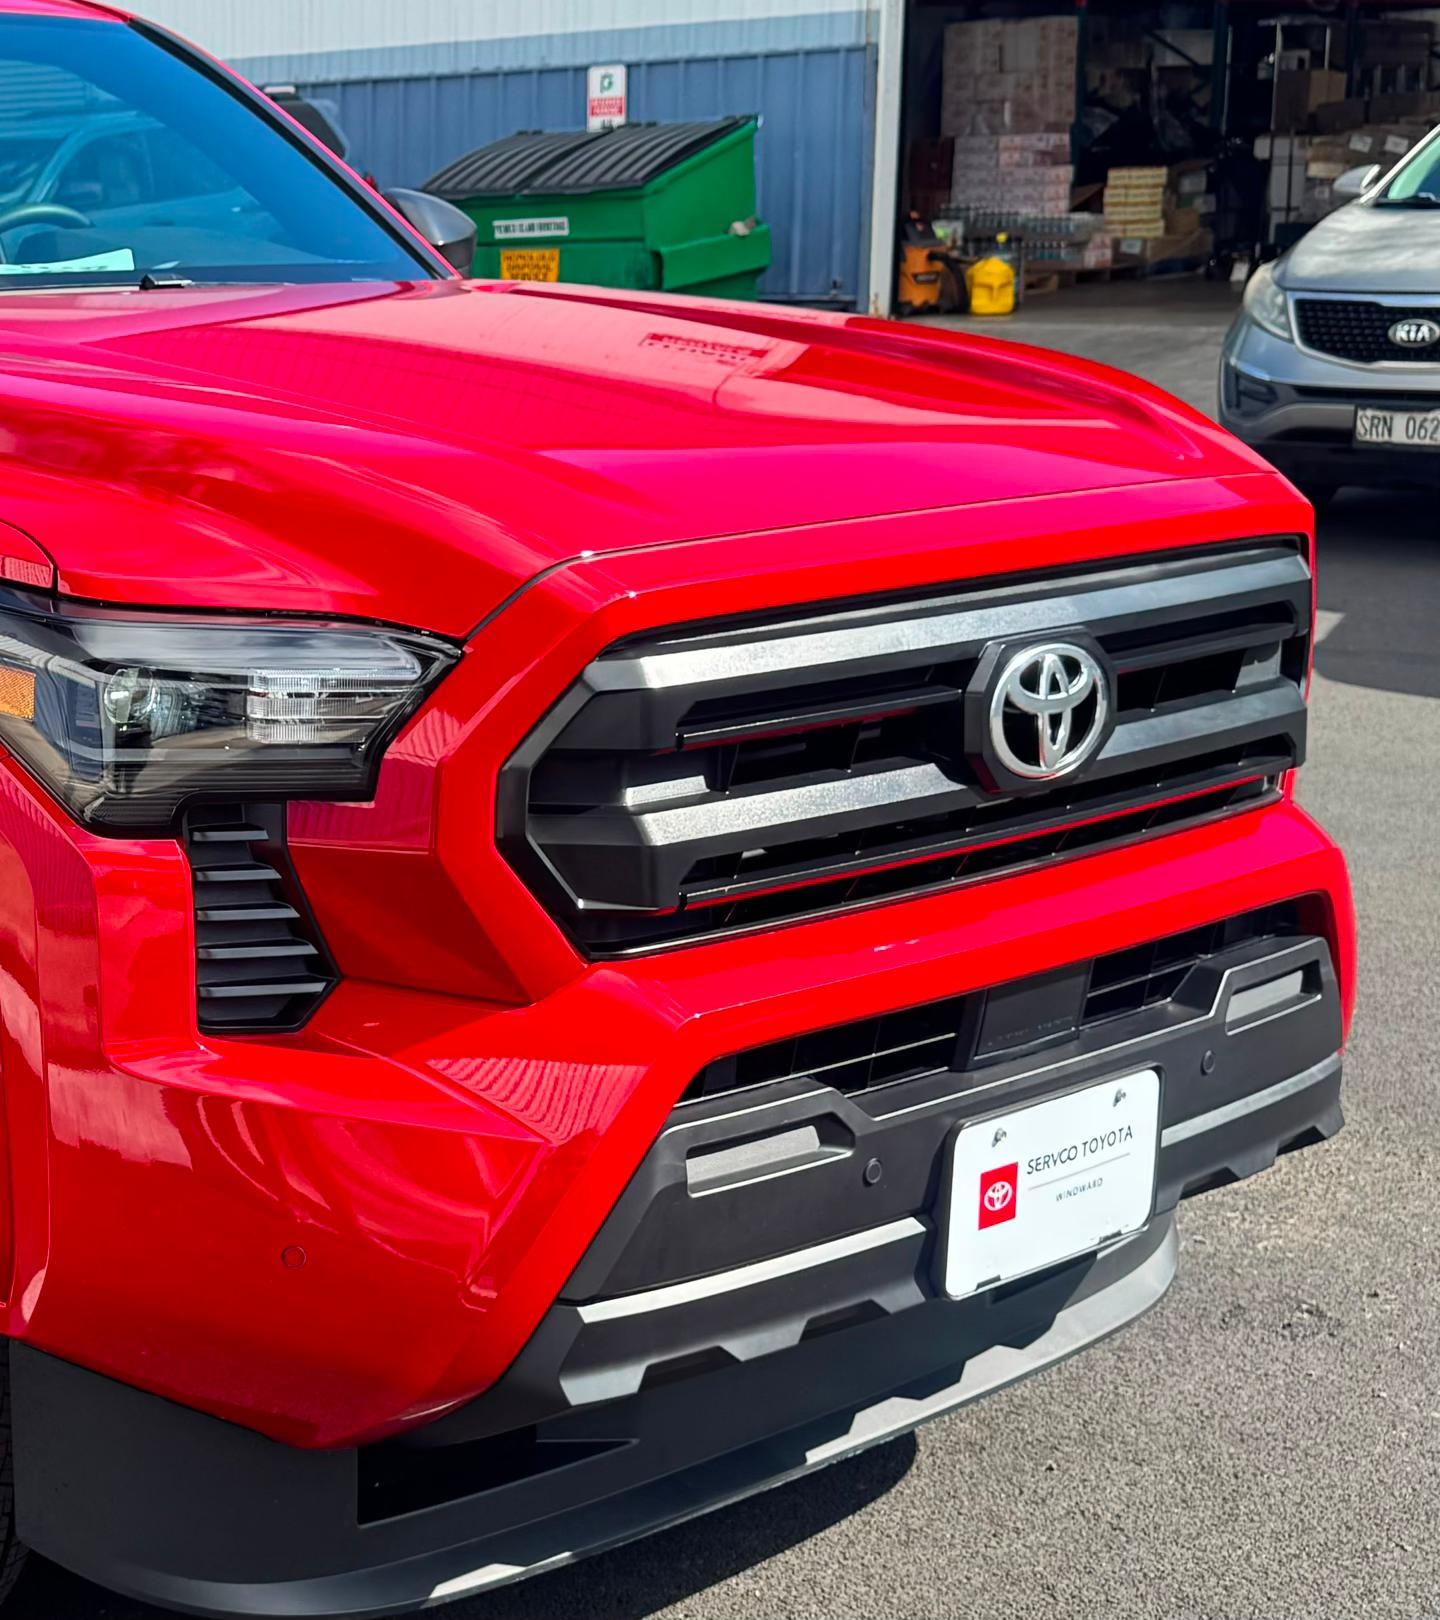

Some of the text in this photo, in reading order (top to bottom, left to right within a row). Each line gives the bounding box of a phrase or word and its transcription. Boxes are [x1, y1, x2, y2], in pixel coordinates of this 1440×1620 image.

[1395, 323, 1431, 342] KIA
[1358, 413, 1440, 441] SRN 062
[1026, 1124, 1133, 1175] SERVCO TOYOTA
[1055, 1177, 1104, 1202] WINDWARD
